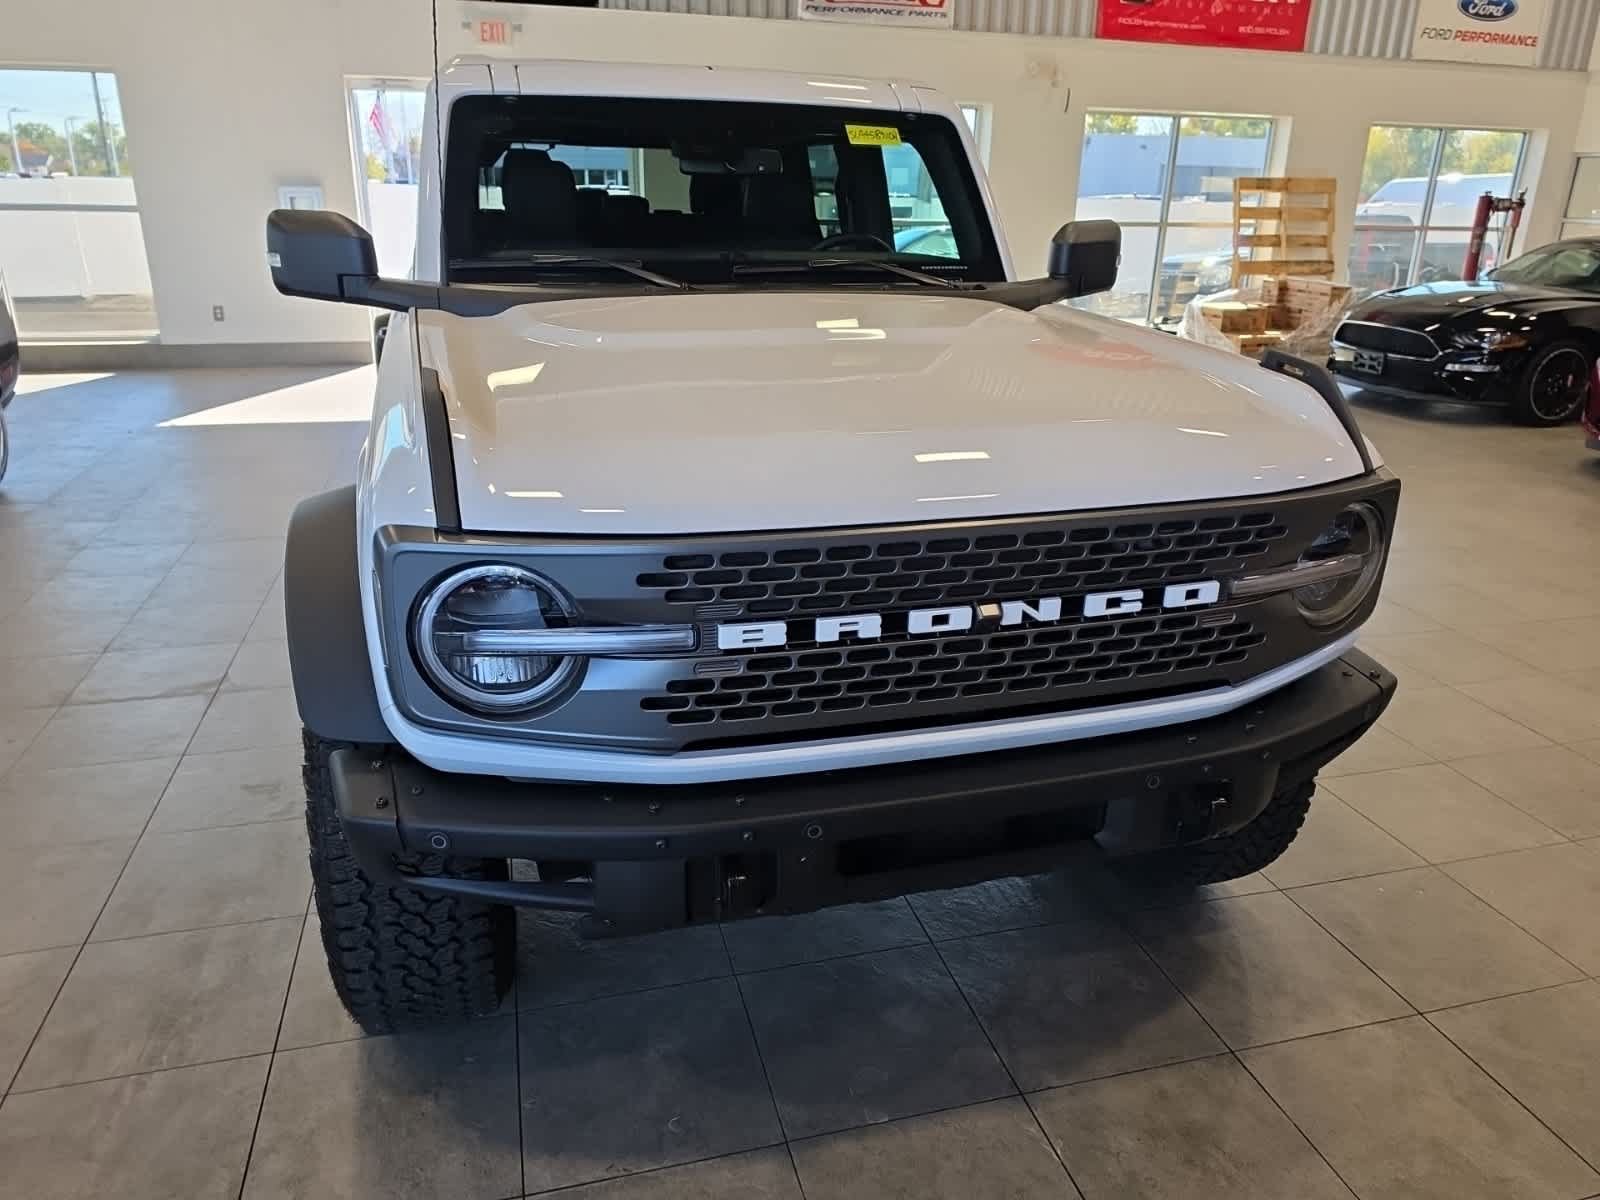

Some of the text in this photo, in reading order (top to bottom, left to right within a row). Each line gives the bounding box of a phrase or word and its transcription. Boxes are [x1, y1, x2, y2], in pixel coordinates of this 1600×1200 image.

[804, 4, 904, 16] PERFORMANCE
[908, 10, 948, 18] PARTS
[1468, 0, 1508, 16] Ford
[480, 22, 506, 42] EXIT
[1420, 27, 1539, 47] FORD PERFORMANCE
[717, 580, 1221, 650] BRONCO
